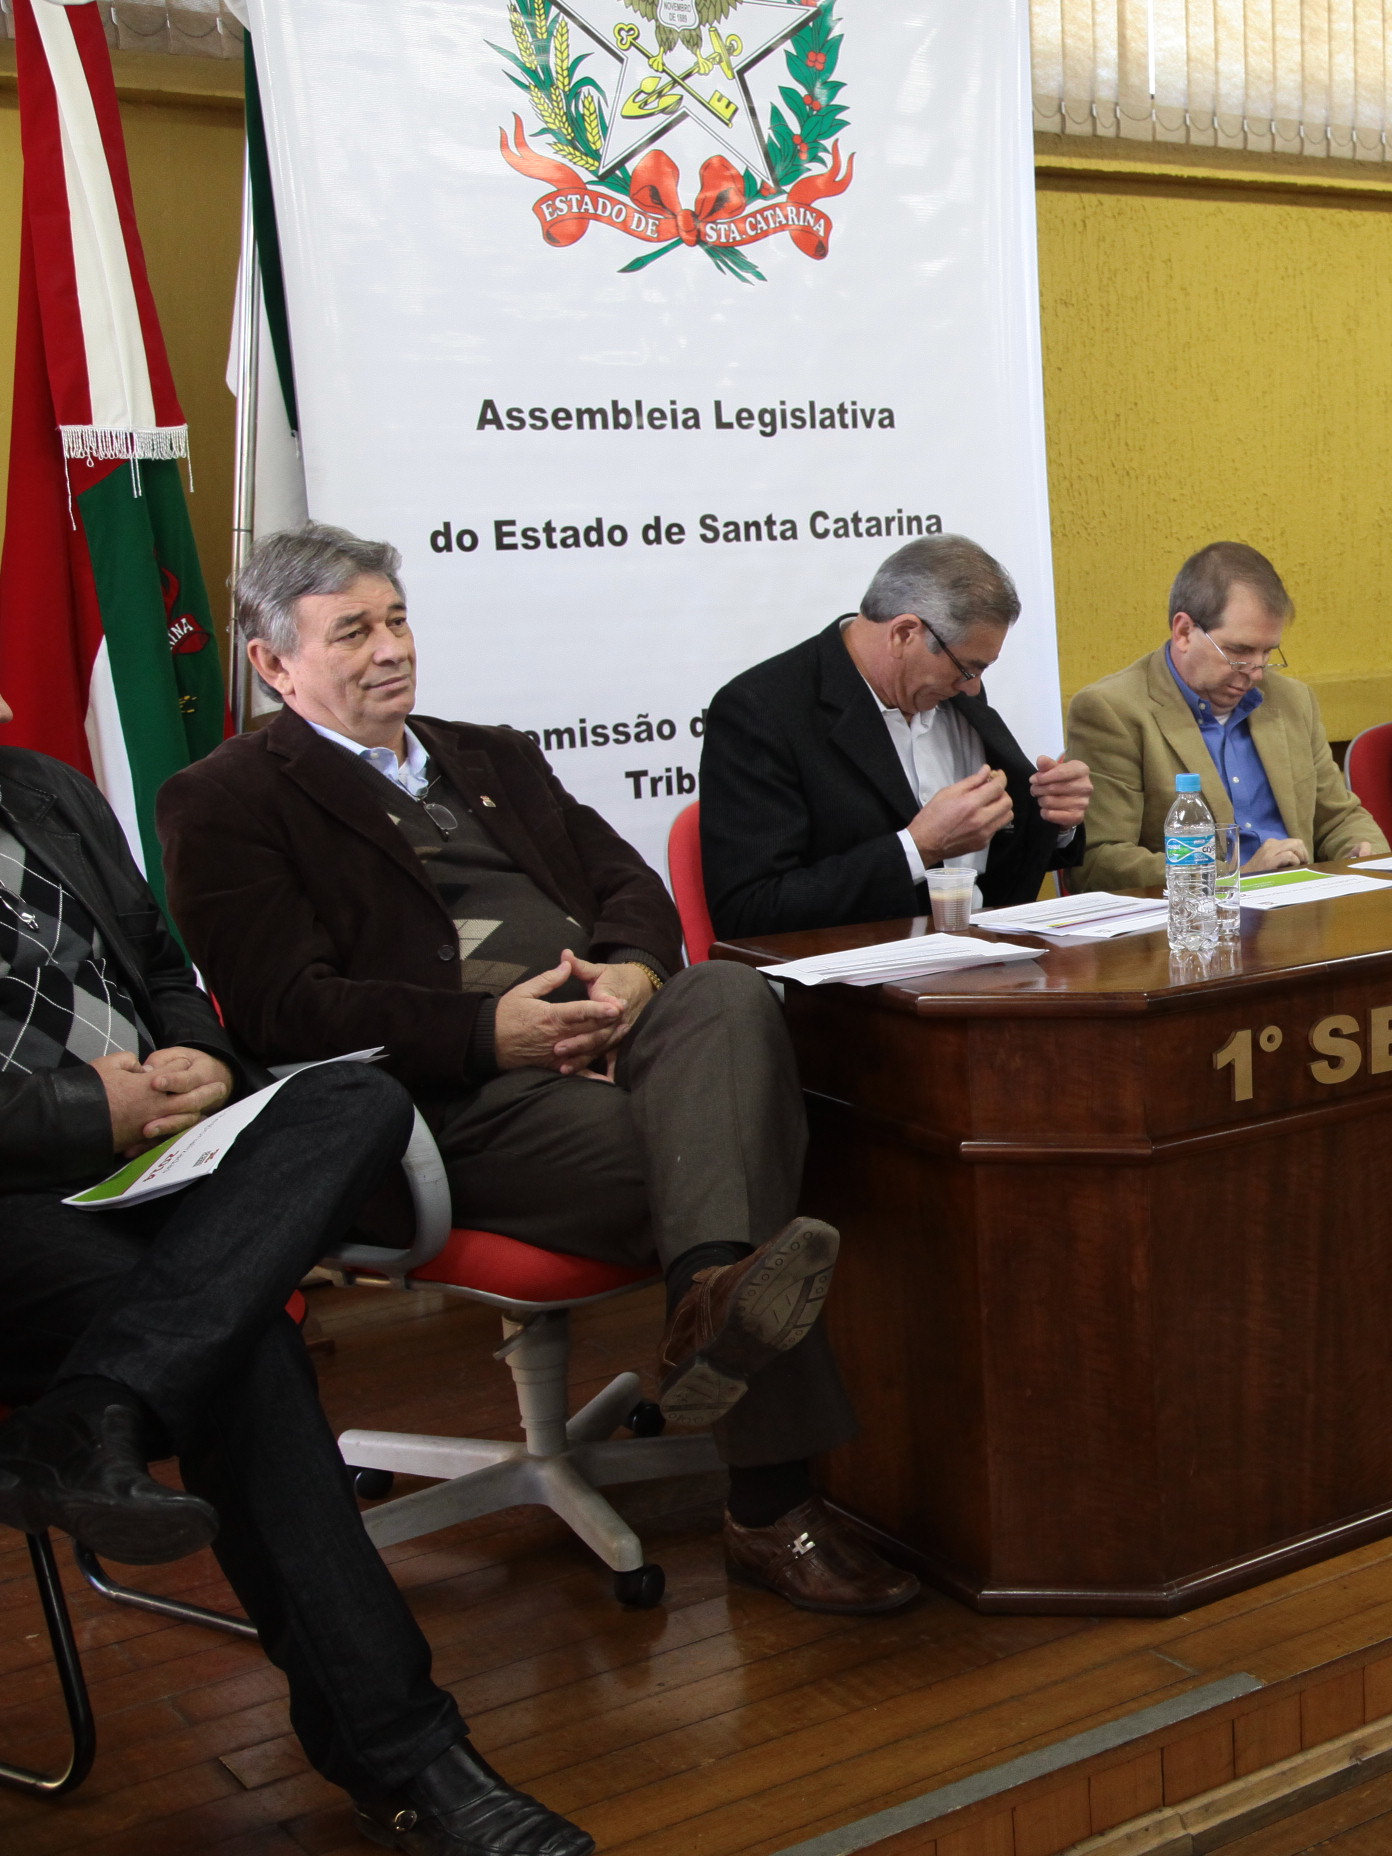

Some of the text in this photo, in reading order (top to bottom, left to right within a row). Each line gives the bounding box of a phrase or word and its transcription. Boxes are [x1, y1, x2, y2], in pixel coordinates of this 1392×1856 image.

[663, 2, 692, 12] NOVEMBRO
[540, 194, 627, 224] ESTADO
[630, 213, 659, 239] DE
[476, 398, 896, 438] Assembleia Legislativa
[429, 507, 944, 554] do Estado de Santa Catarina
